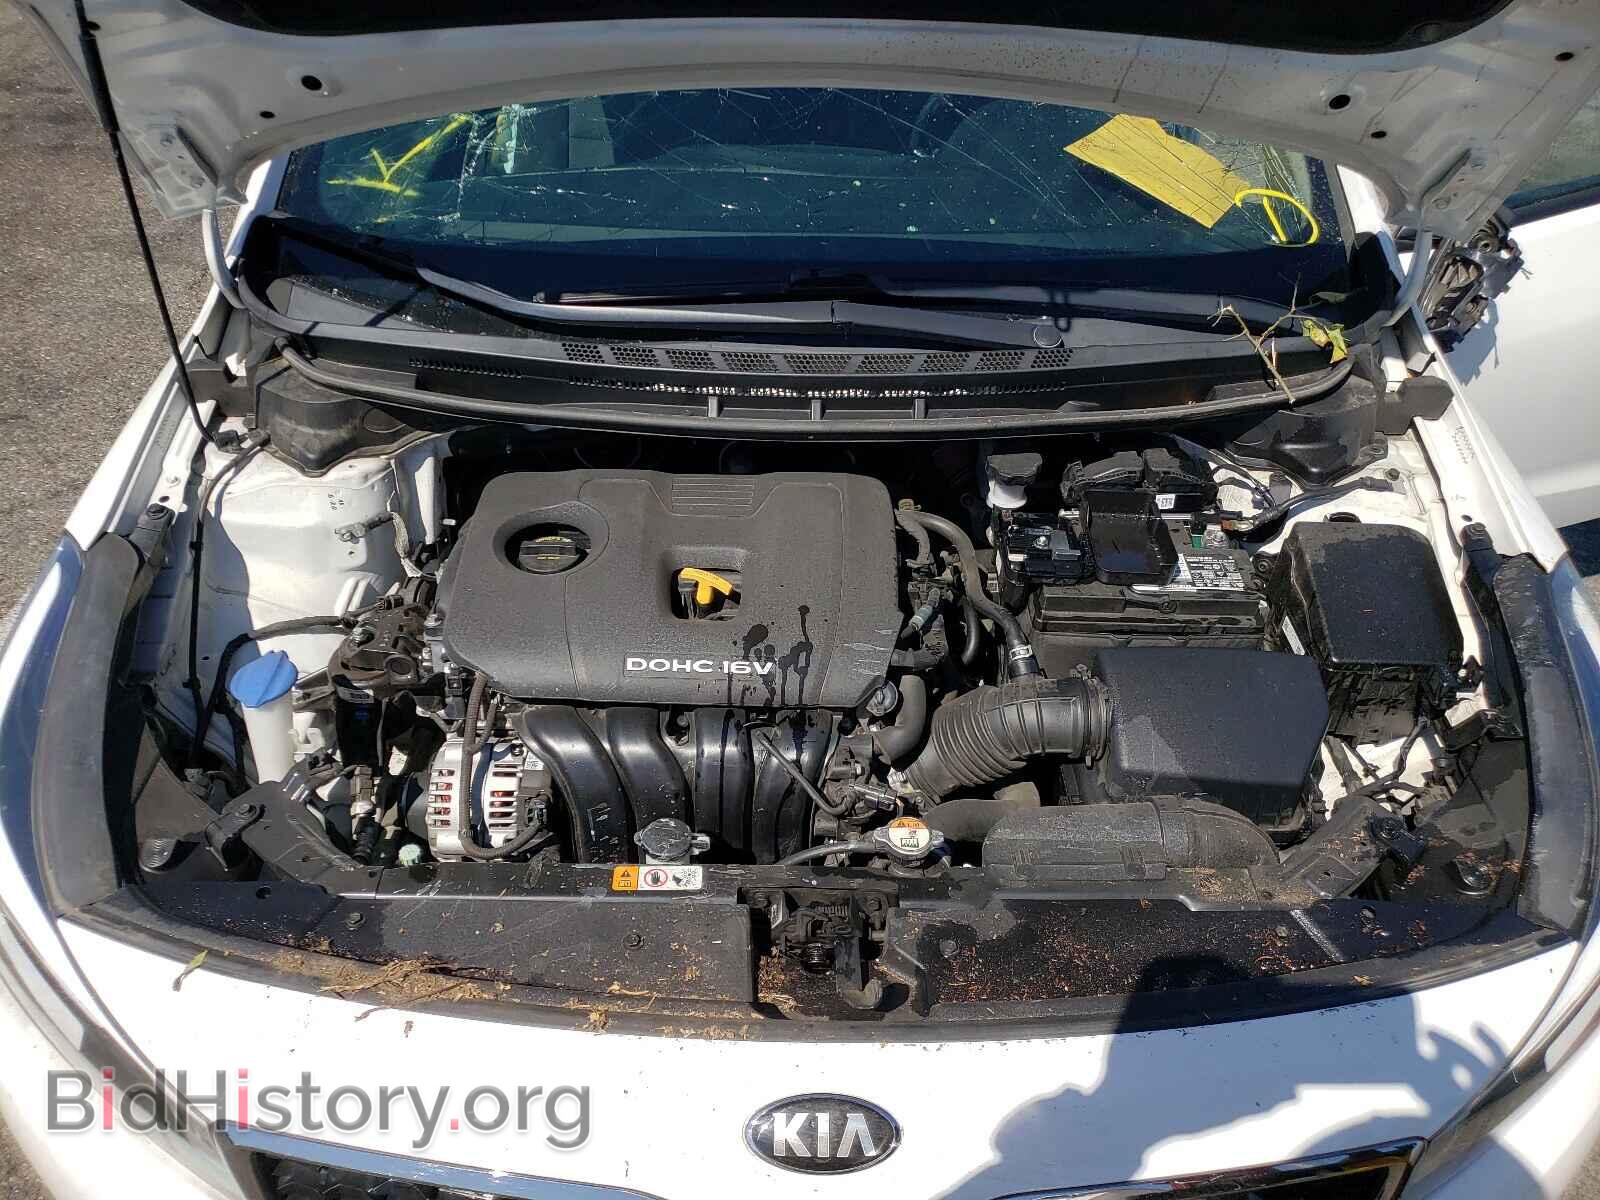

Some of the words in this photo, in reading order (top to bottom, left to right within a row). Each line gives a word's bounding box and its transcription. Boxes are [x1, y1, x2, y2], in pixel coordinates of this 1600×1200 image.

[626, 657, 714, 673] DOHC
[722, 660, 775, 675] 16V
[772, 1112, 878, 1158] KIA
